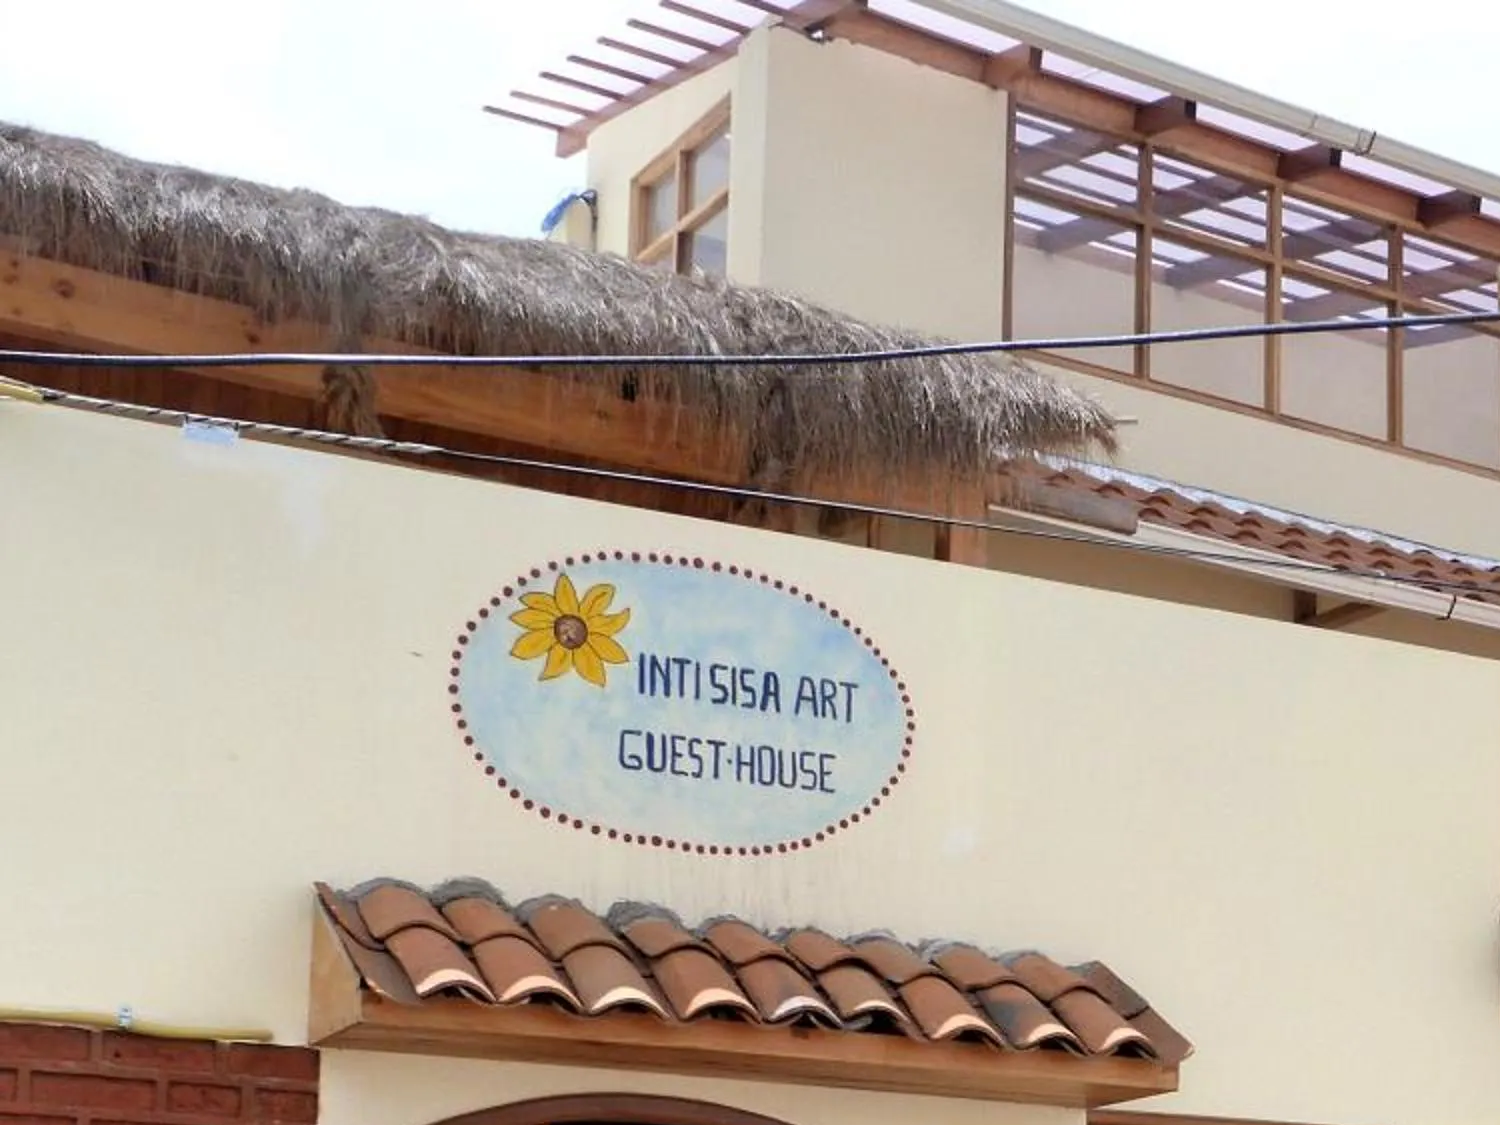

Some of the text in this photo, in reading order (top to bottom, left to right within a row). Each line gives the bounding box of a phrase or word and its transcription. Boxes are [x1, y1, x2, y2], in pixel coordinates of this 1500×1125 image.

[637, 652, 859, 723] INTI SISA ART
